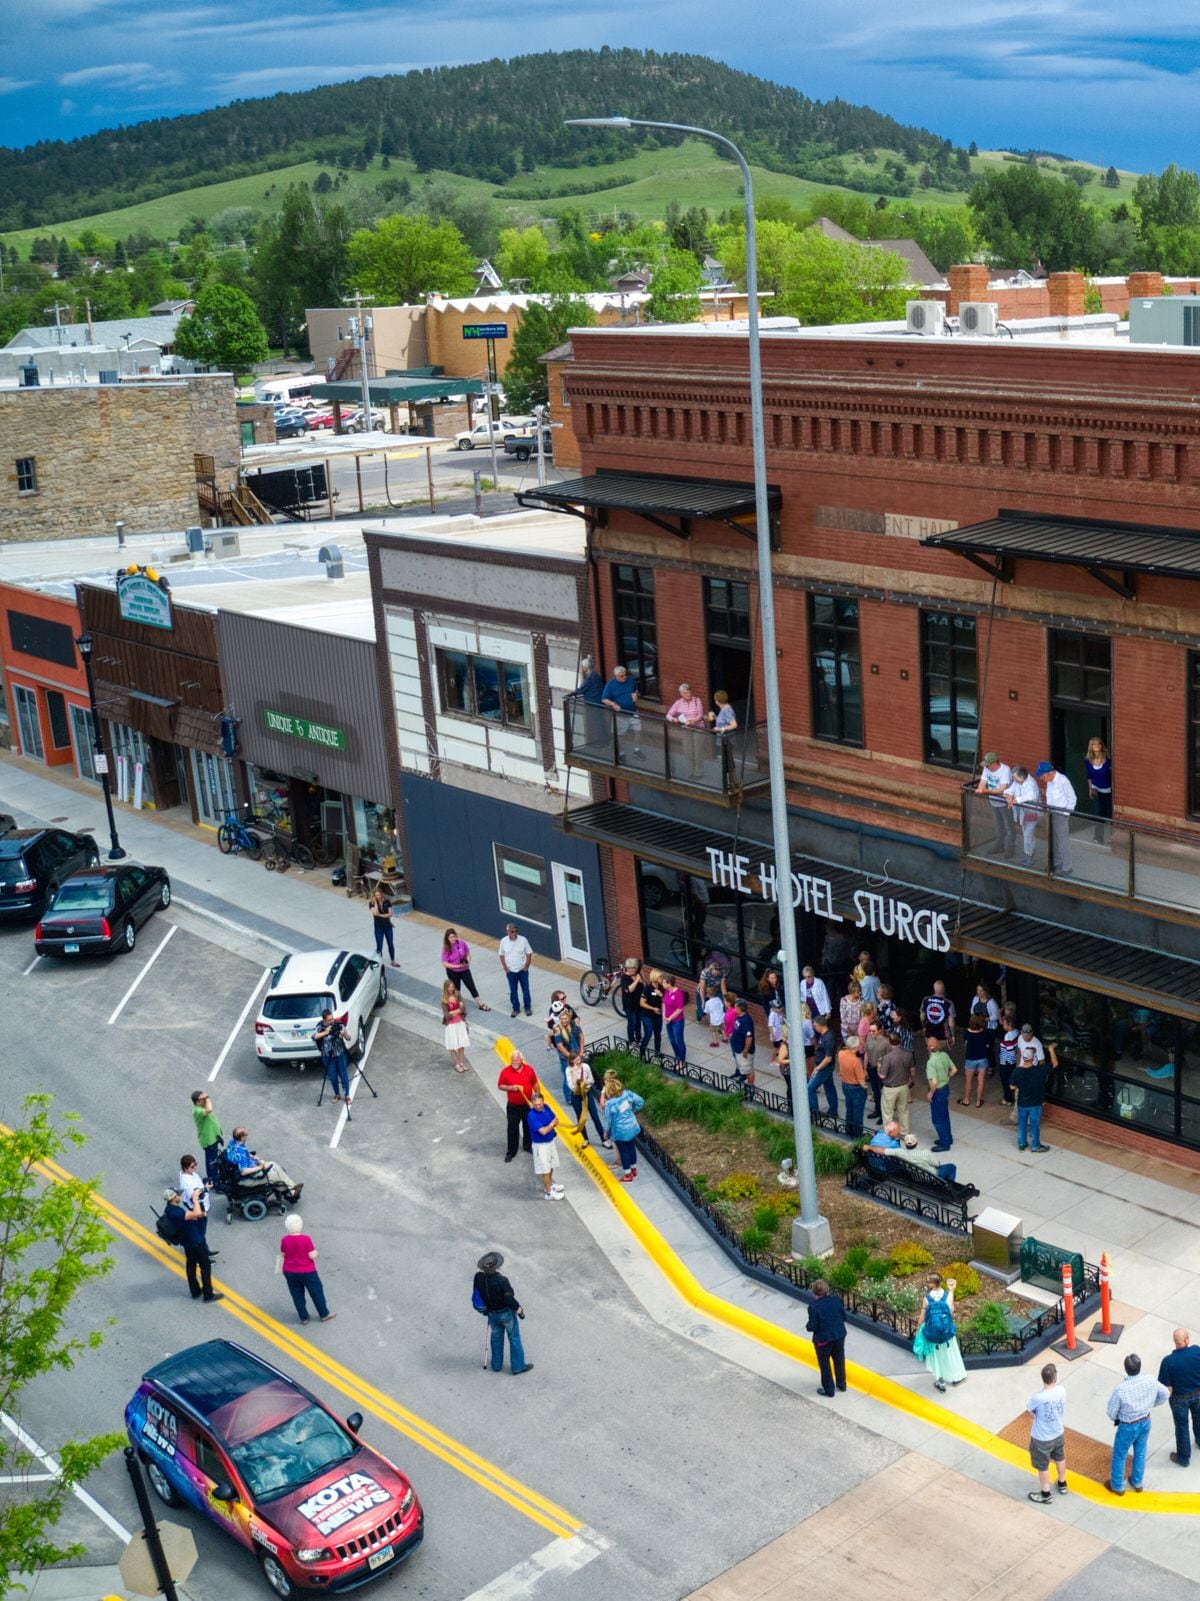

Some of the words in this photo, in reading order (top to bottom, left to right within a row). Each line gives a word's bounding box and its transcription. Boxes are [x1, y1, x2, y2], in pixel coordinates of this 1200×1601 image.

[919, 519, 953, 538] HAL
[266, 711, 294, 733] UNIQUE
[308, 724, 339, 747] ANTIQUE
[706, 846, 751, 895] THE
[853, 889, 950, 953] STURGIS
[147, 1395, 178, 1437] KOTA
[297, 1473, 376, 1520] KOTA
[317, 1489, 391, 1536] NEWS
